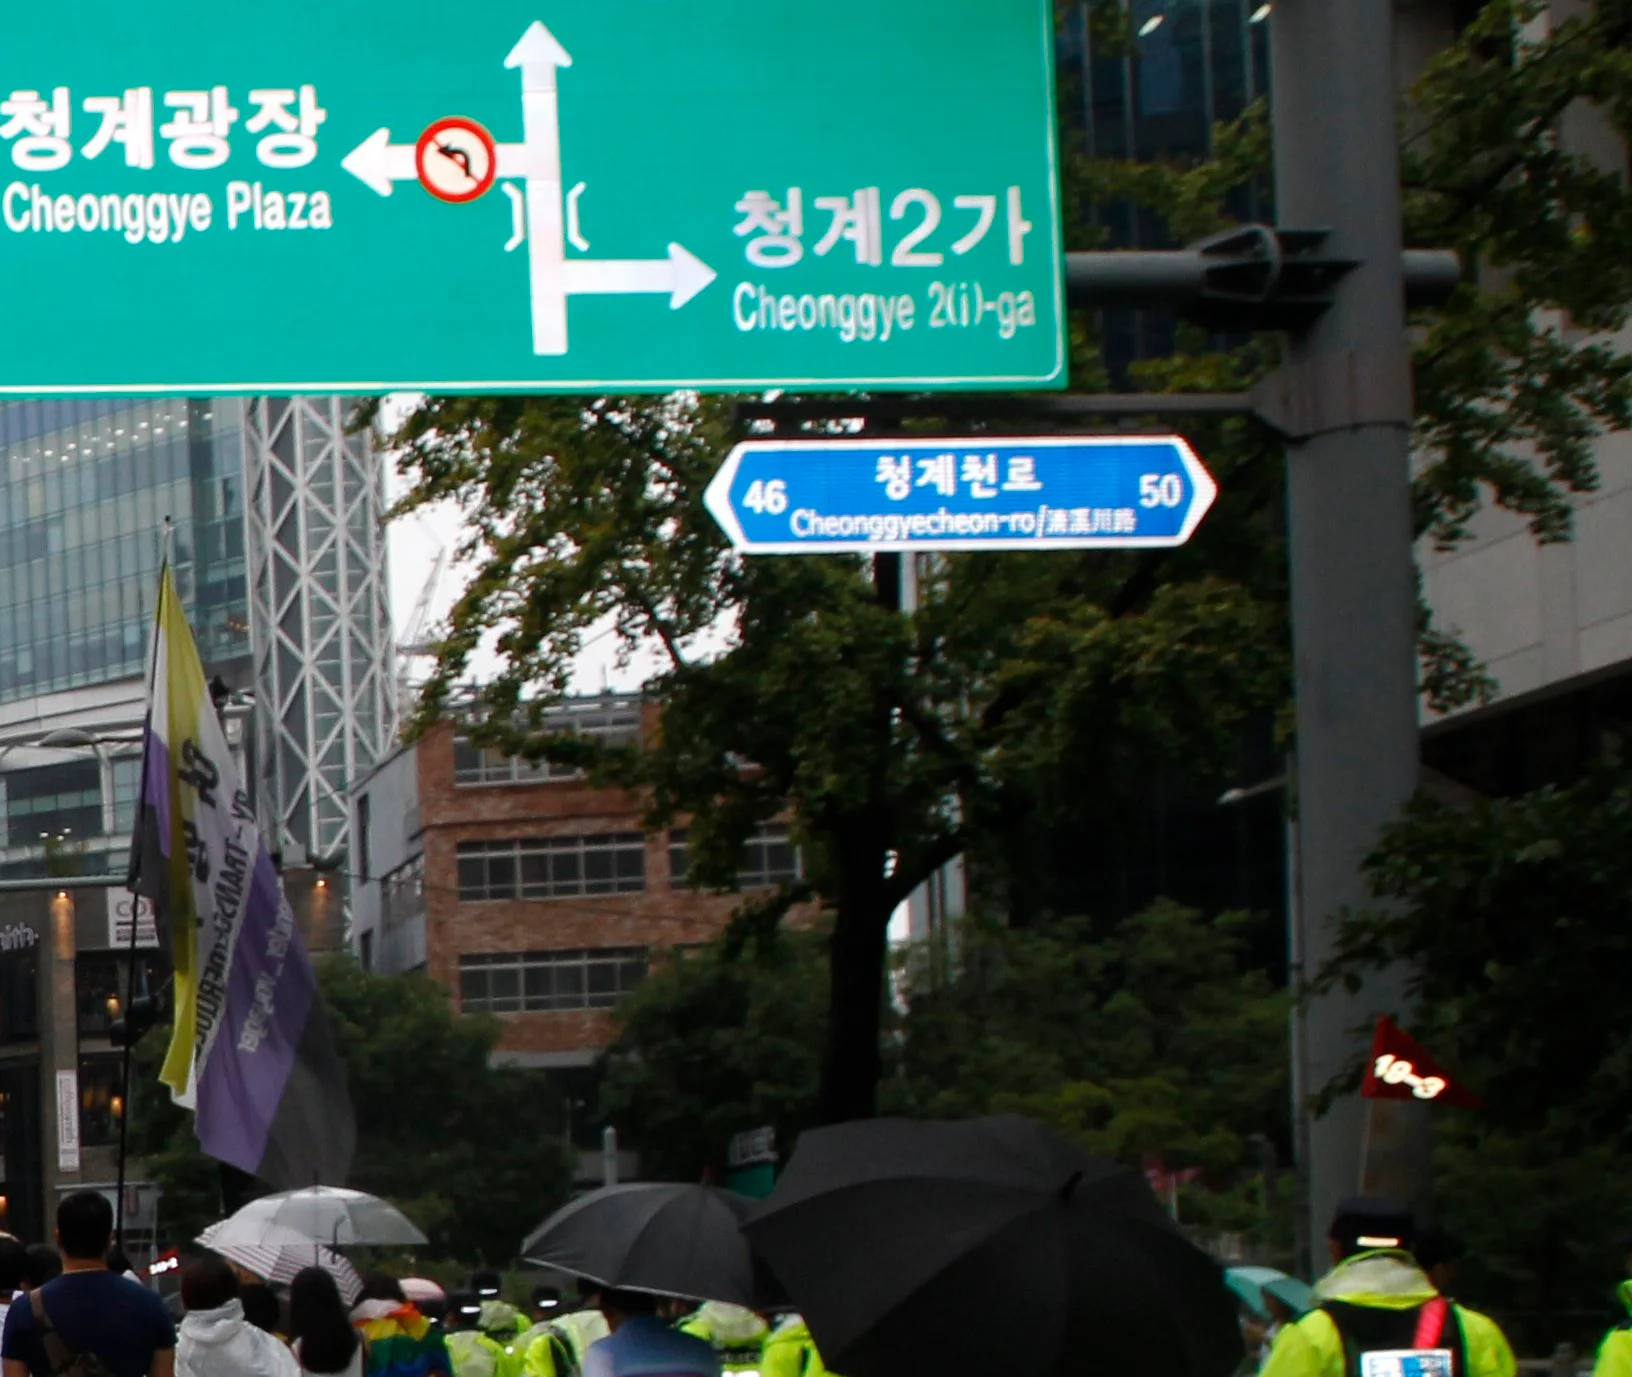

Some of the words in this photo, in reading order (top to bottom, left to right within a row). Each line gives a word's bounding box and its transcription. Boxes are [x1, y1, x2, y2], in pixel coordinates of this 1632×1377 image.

[2, 181, 213, 244] Cheonggye
[226, 180, 333, 231] Plaza
[733, 185, 1033, 268] 청계2가
[734, 281, 915, 342] Cheonggye
[927, 281, 1036, 339] 2(i)-ga
[742, 478, 788, 515] 46
[875, 453, 1044, 501] 청계천로
[1138, 473, 1182, 508] 50
